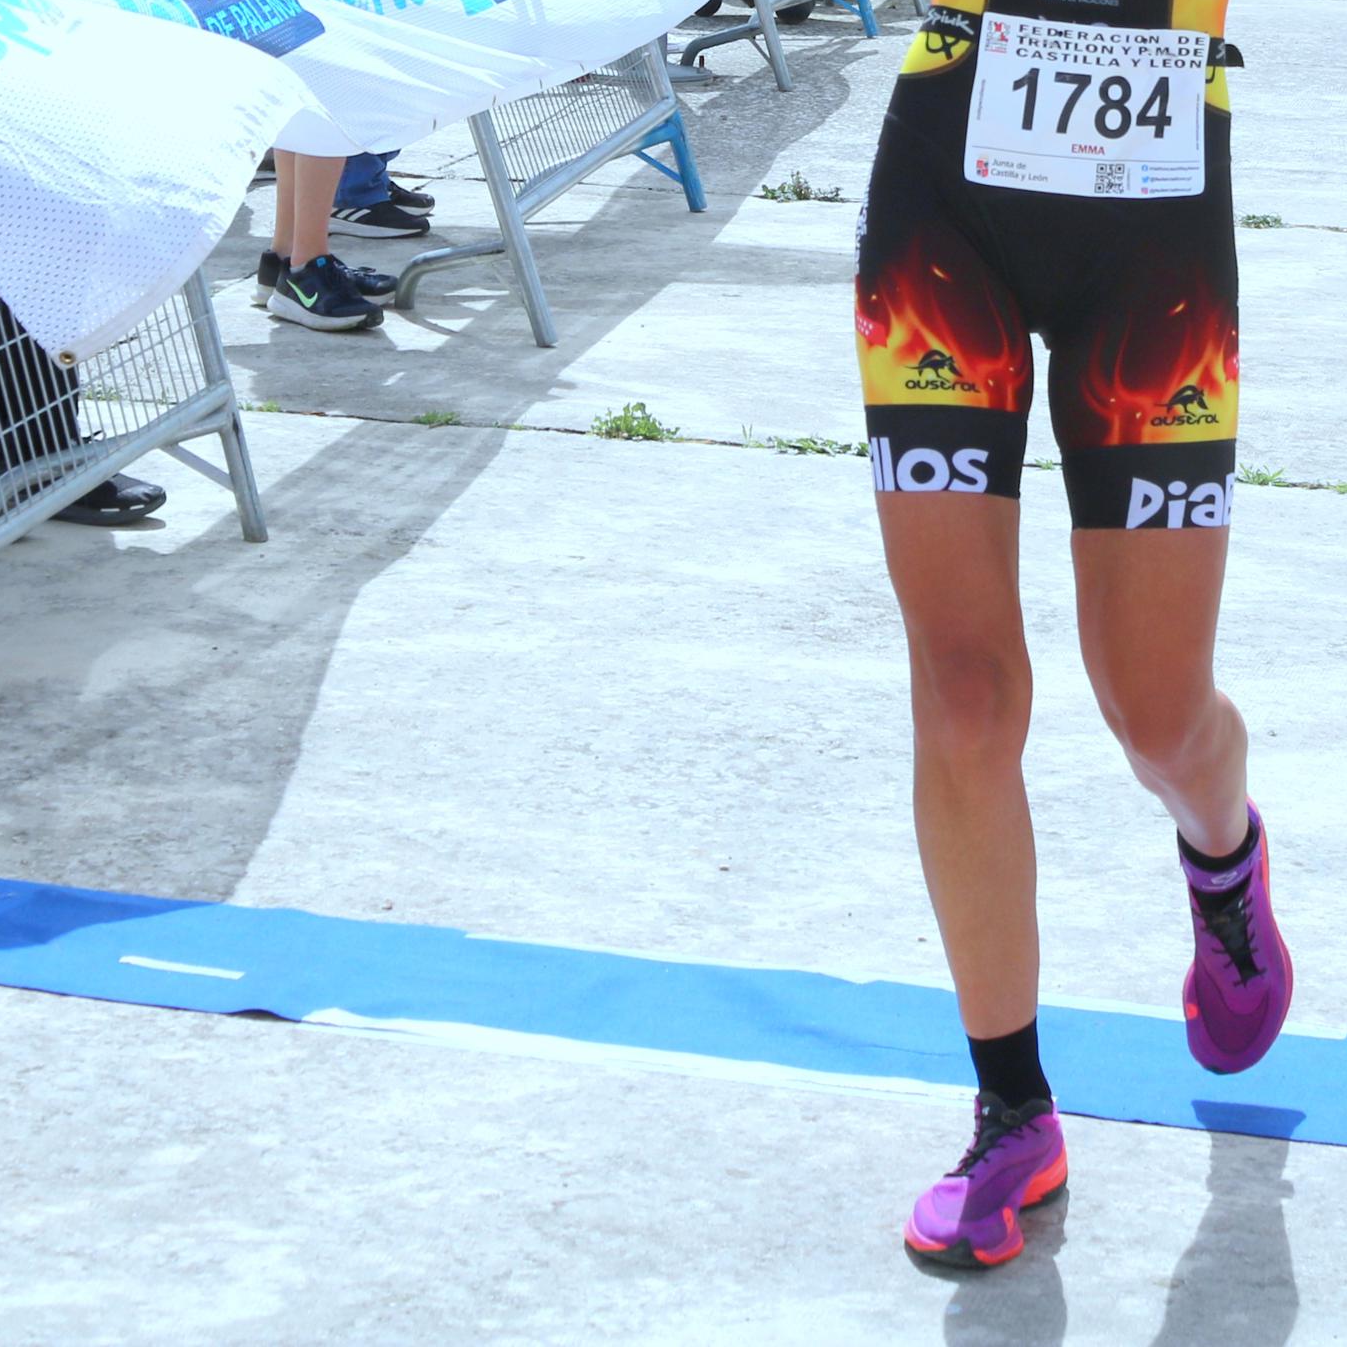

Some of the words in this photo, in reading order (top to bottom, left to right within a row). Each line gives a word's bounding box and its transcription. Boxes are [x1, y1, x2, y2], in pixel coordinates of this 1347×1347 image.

[1178, 36, 1206, 46] DE
[1016, 47, 1120, 67] CASTILLA
[1131, 58, 1141, 67] Y
[1121, 46, 1131, 55] Y
[1178, 48, 1205, 58] DE
[1012, 67, 1172, 140] 1784
[1071, 143, 1106, 155] EMMA
